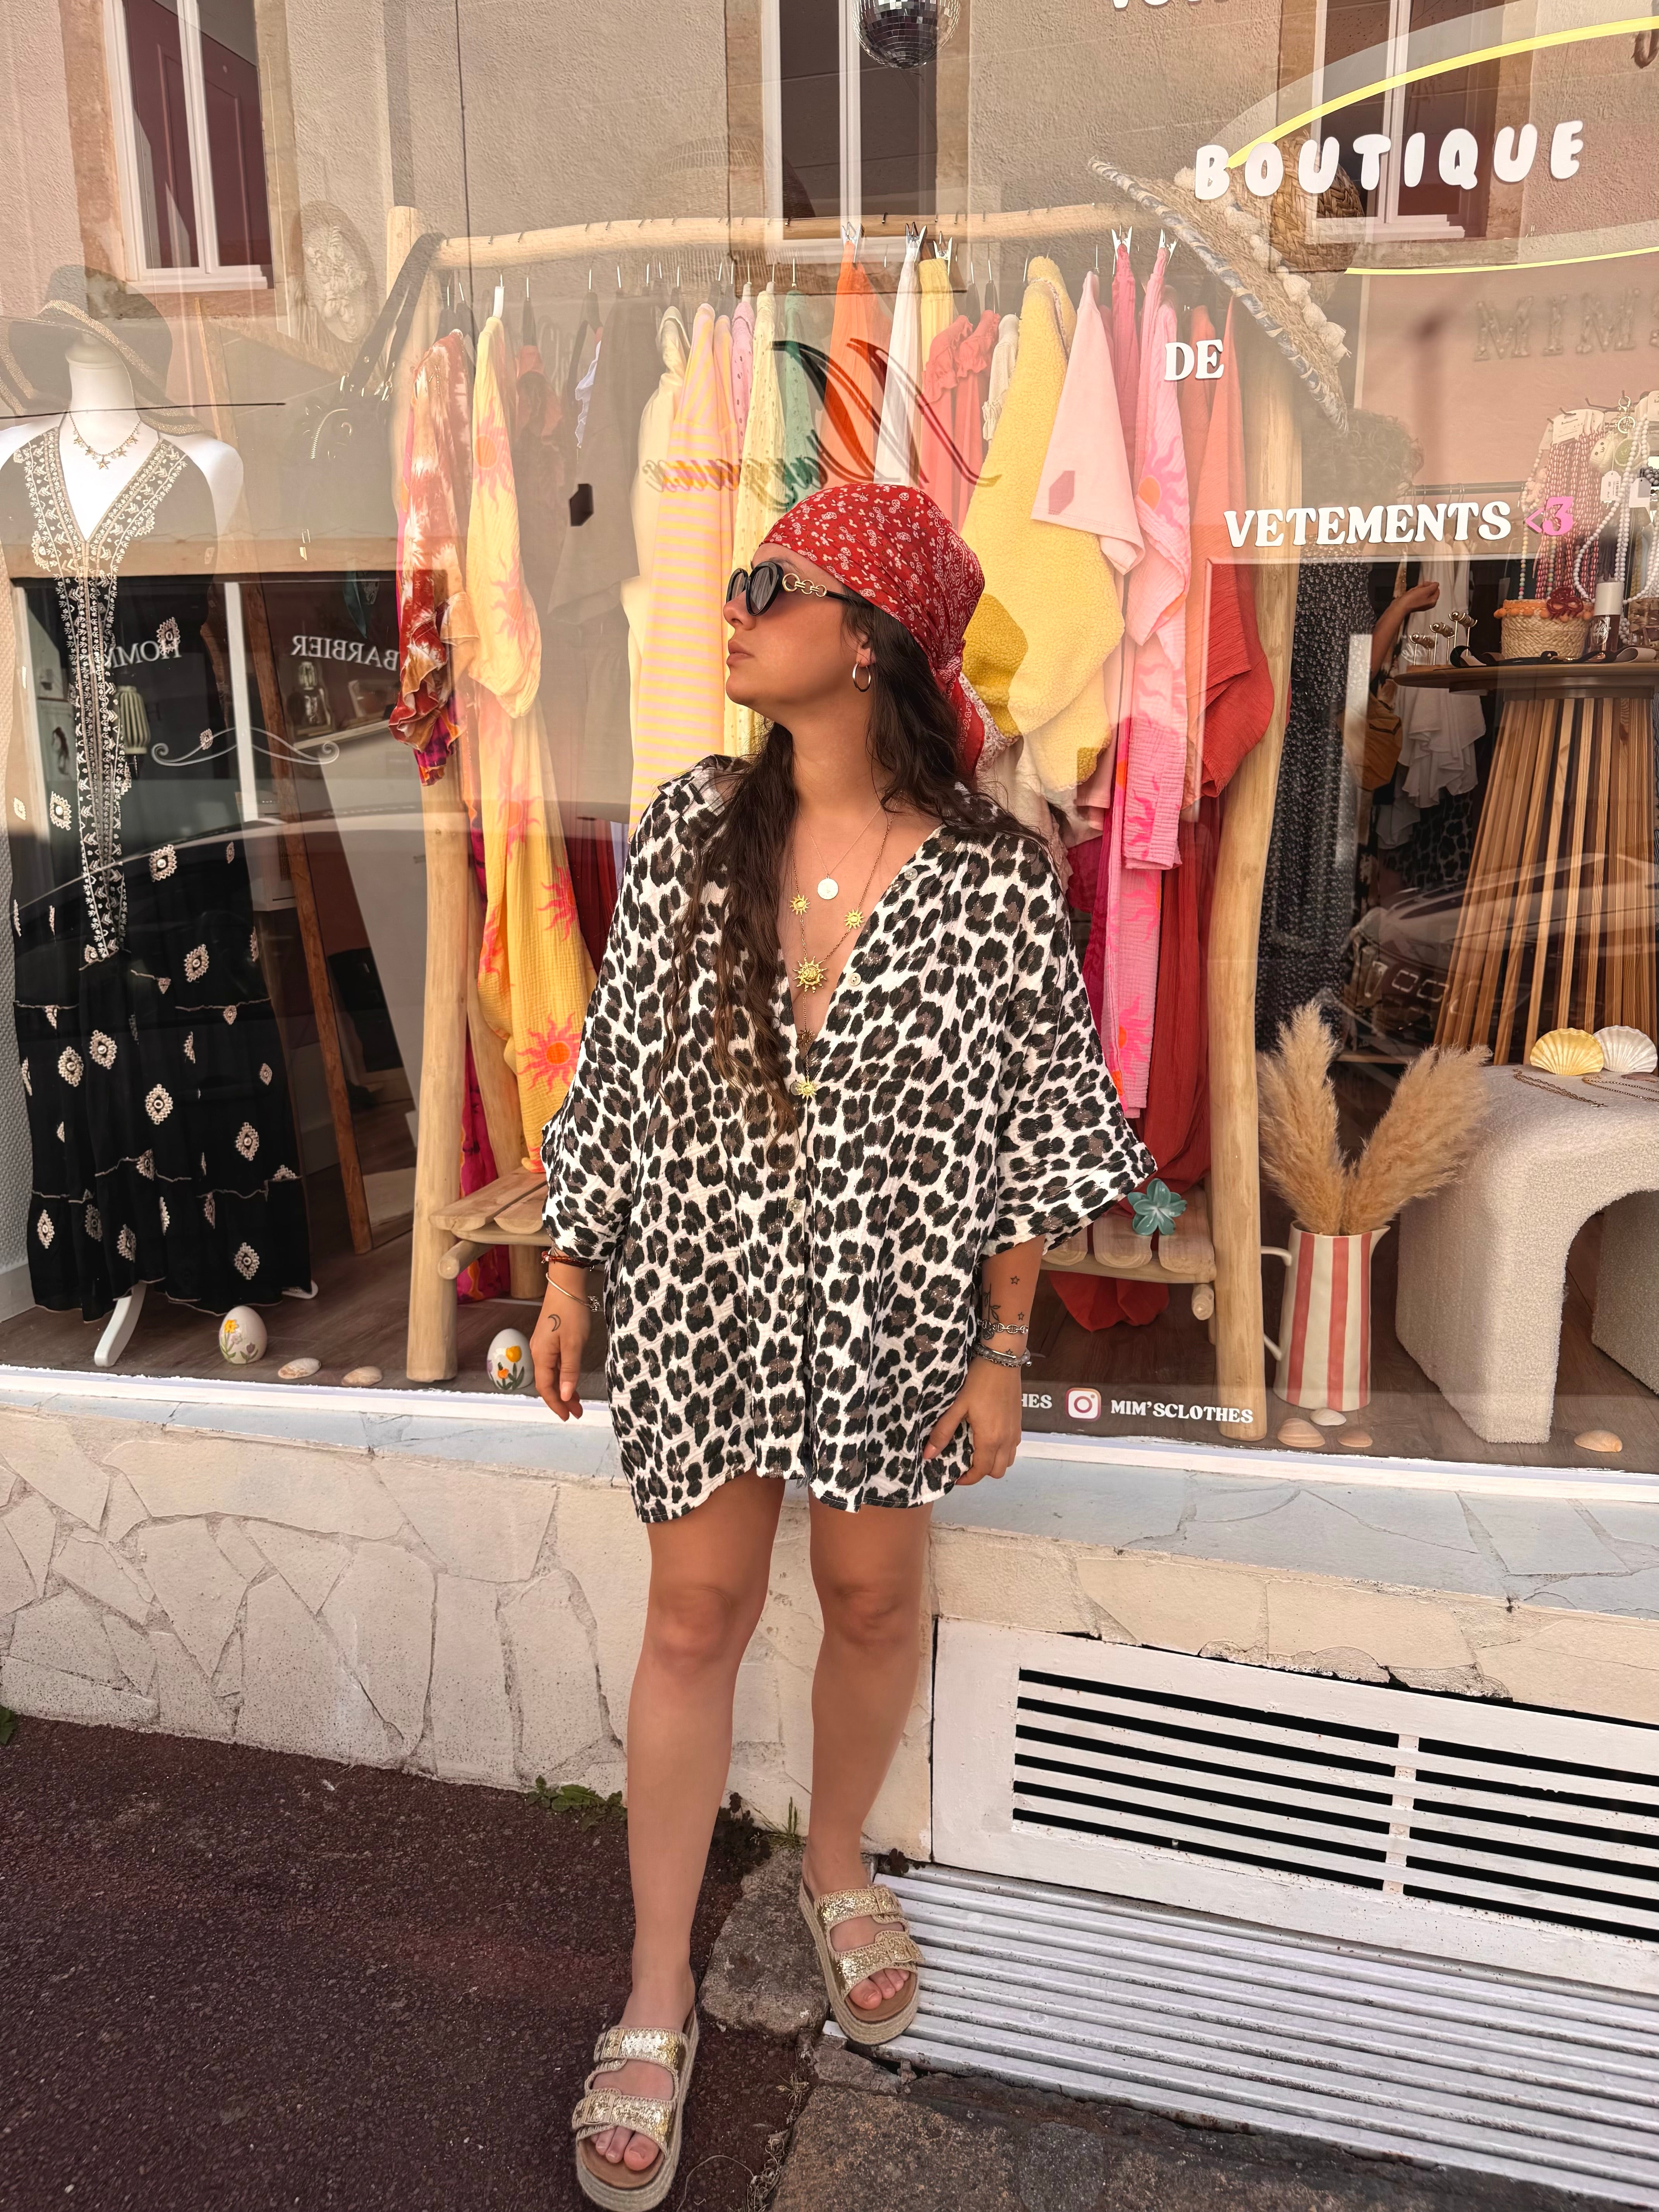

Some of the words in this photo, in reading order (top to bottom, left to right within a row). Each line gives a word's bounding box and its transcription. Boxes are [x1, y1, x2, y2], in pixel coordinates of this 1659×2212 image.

[1194, 120, 1583, 200] BOUTIQUE
[1474, 288, 1659, 361] MIM
[1164, 339, 1224, 381] DE
[1223, 501, 1511, 548] VETEMENTS
[1111, 1400, 1254, 1424] MIM'SCLOTHES
